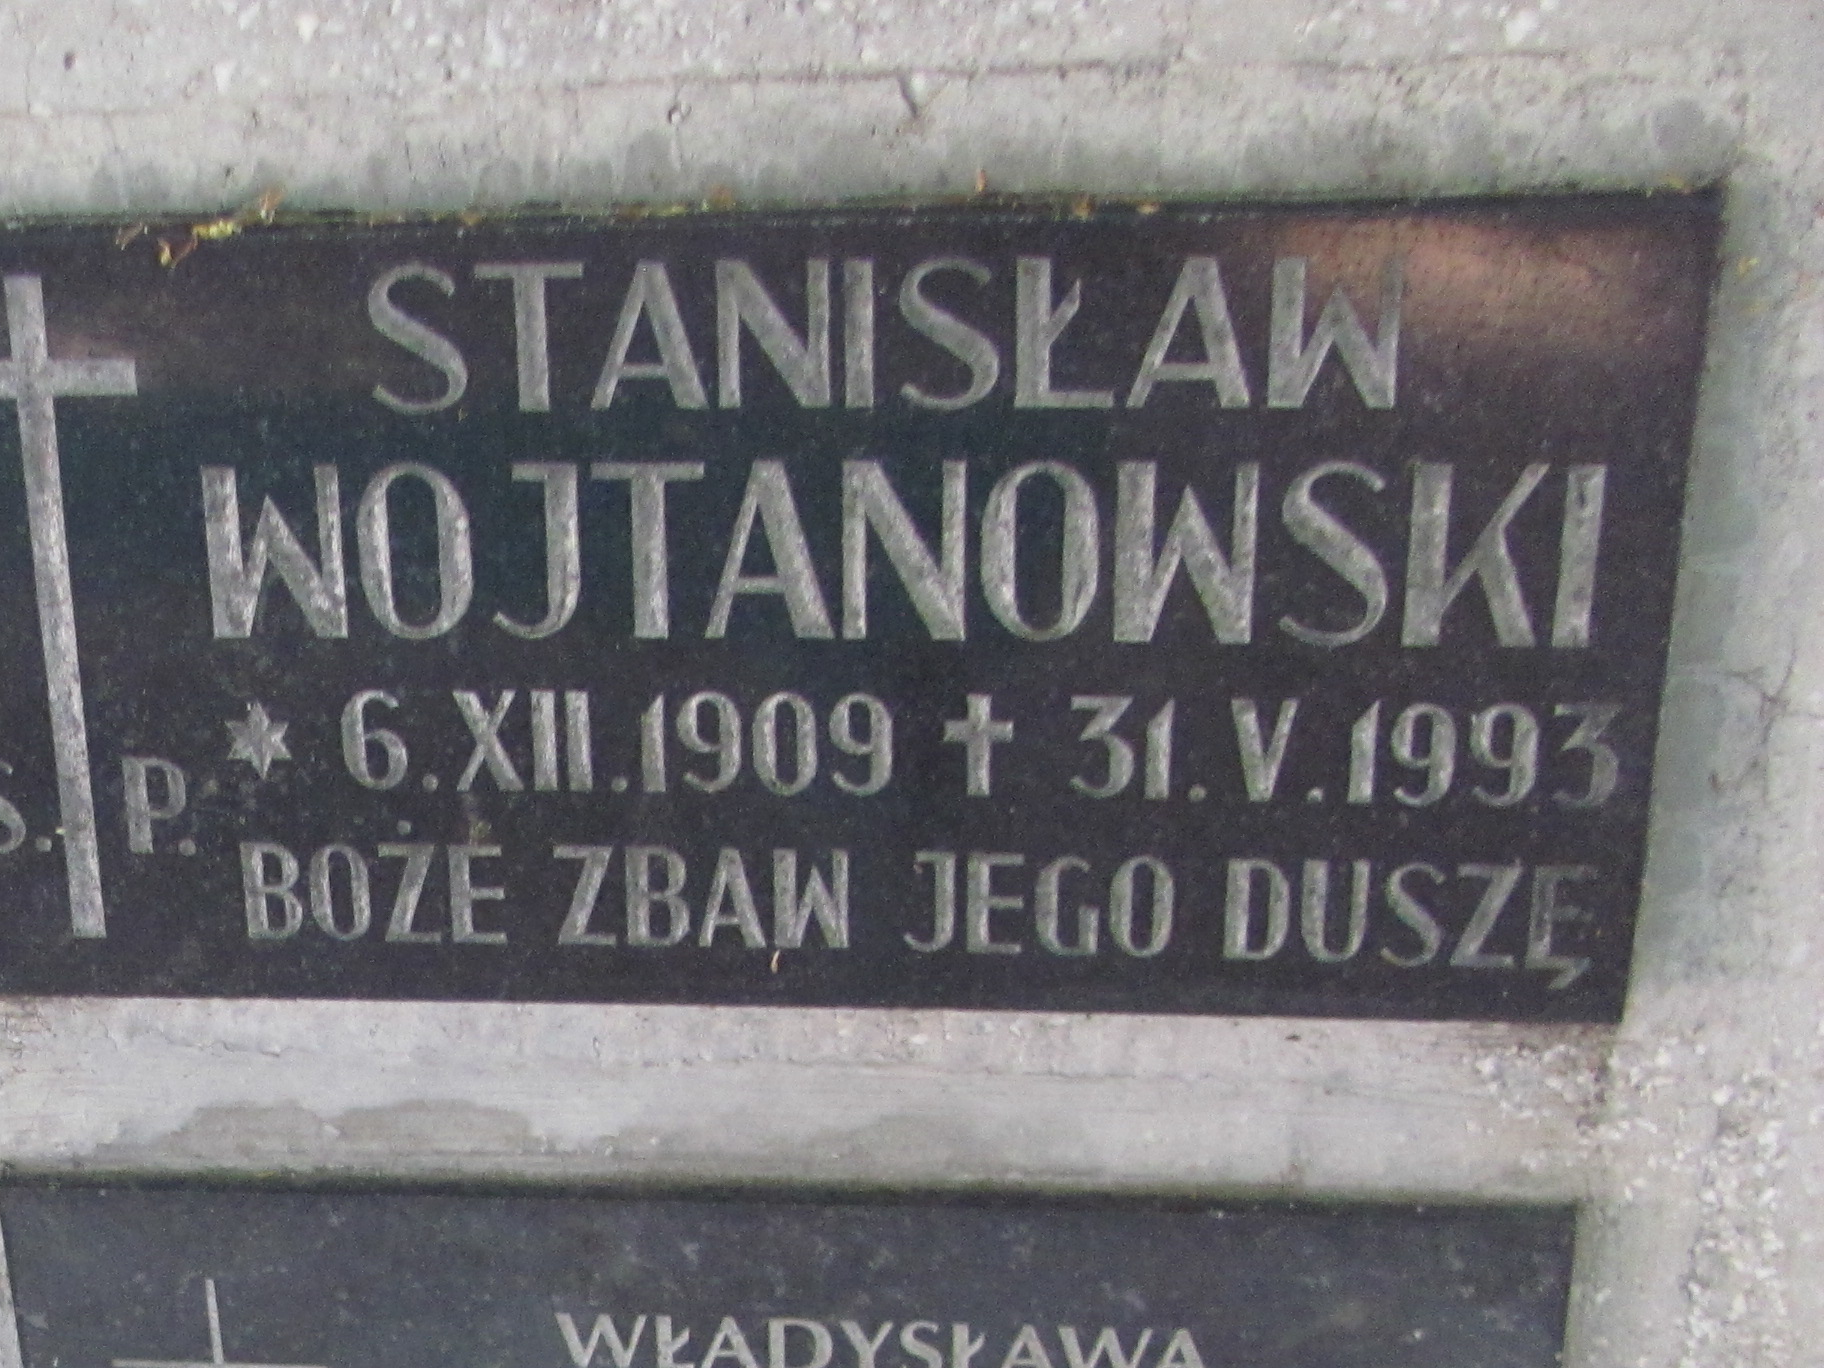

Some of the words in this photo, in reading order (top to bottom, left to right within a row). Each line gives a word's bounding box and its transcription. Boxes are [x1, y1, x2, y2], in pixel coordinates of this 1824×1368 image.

[367, 256, 1406, 412] STANISŁAW
[200, 459, 1607, 649] WOJTANOWSKI
[341, 689, 894, 797] 6.XII.1909
[239, 817, 508, 945] BOŻE
[553, 841, 850, 949] ZBAW
[904, 850, 1174, 957] JEGO
[1222, 856, 1599, 990] DUSZĘ
